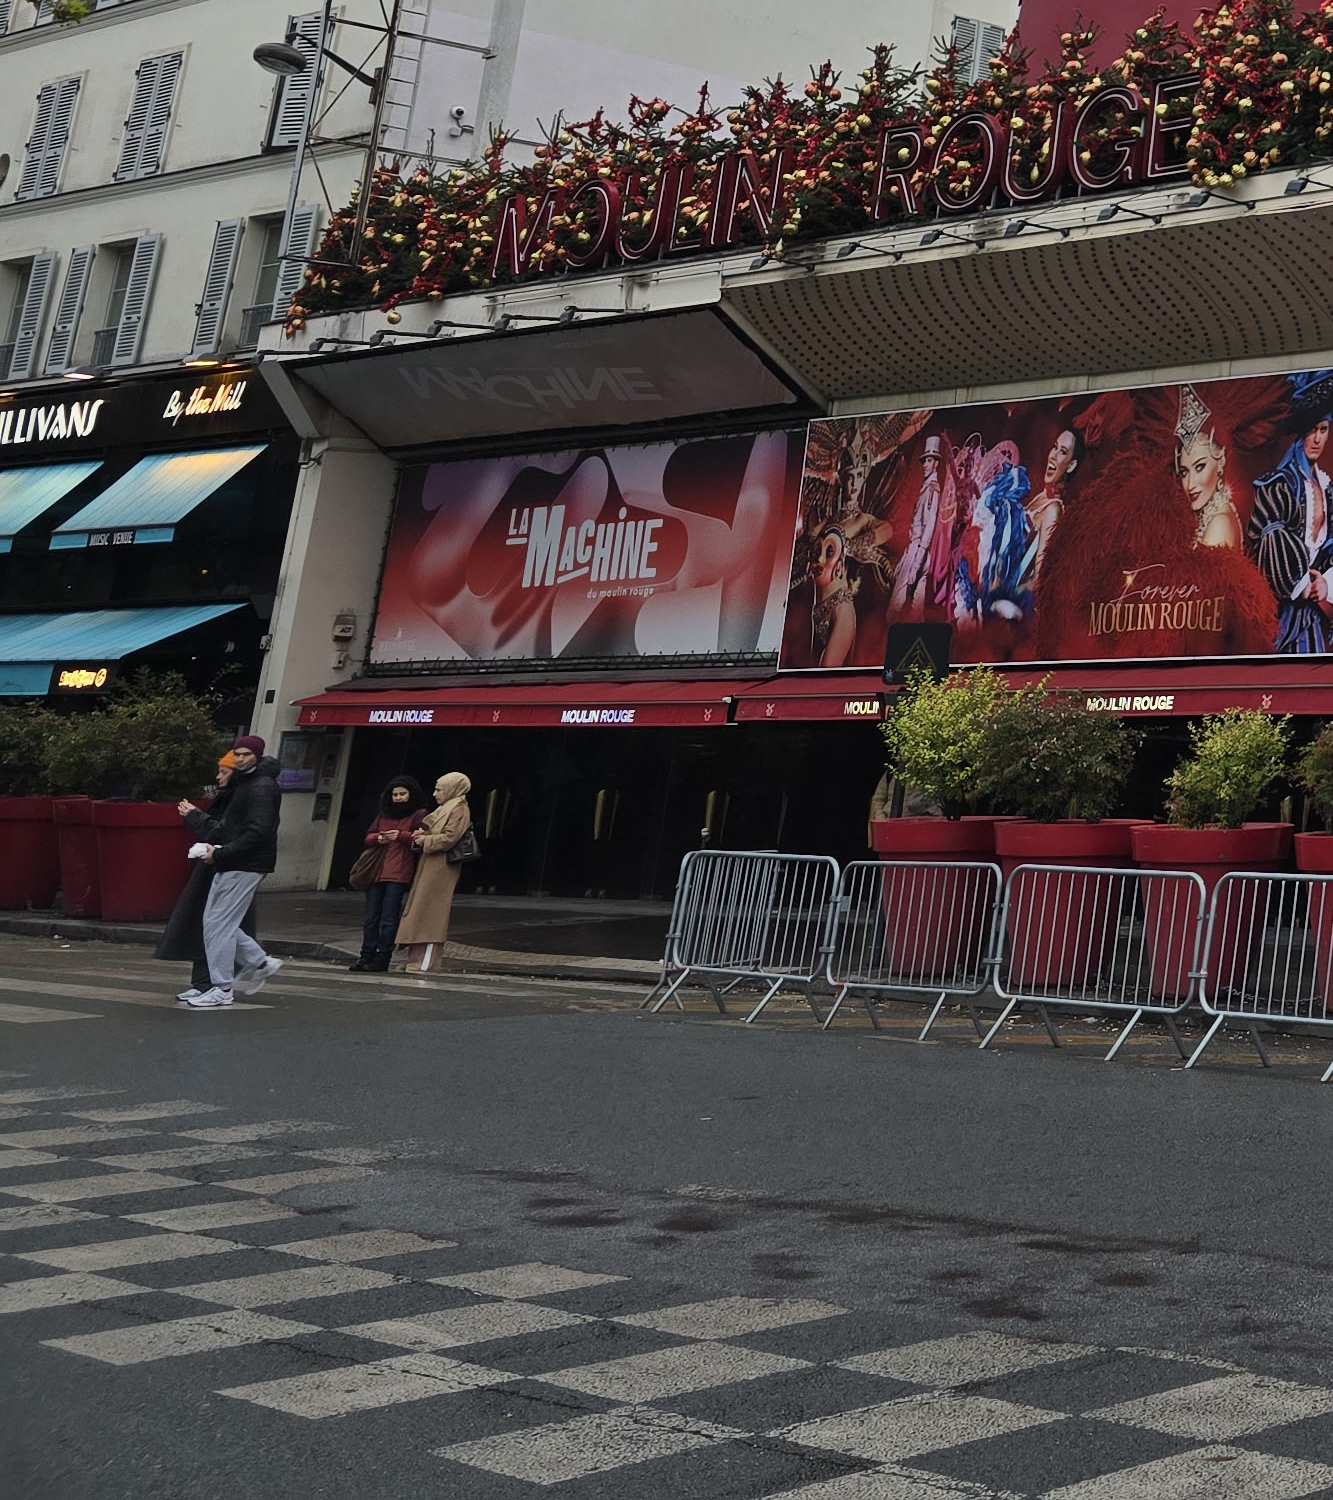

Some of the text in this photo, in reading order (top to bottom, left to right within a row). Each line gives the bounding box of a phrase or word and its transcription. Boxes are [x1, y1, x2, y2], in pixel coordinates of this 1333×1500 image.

[490, 72, 1202, 278] MOULIN ROUGE
[163, 380, 247, 428] By the Mill
[507, 507, 530, 537] LA
[1110, 563, 1201, 614] Forever
[1088, 596, 1226, 637] MOULIN ROUGE
[368, 709, 434, 723] MOULIN ROUGE
[560, 709, 636, 723] MOULIN ROUGE
[1086, 695, 1175, 712] MOULIN ROUGE
